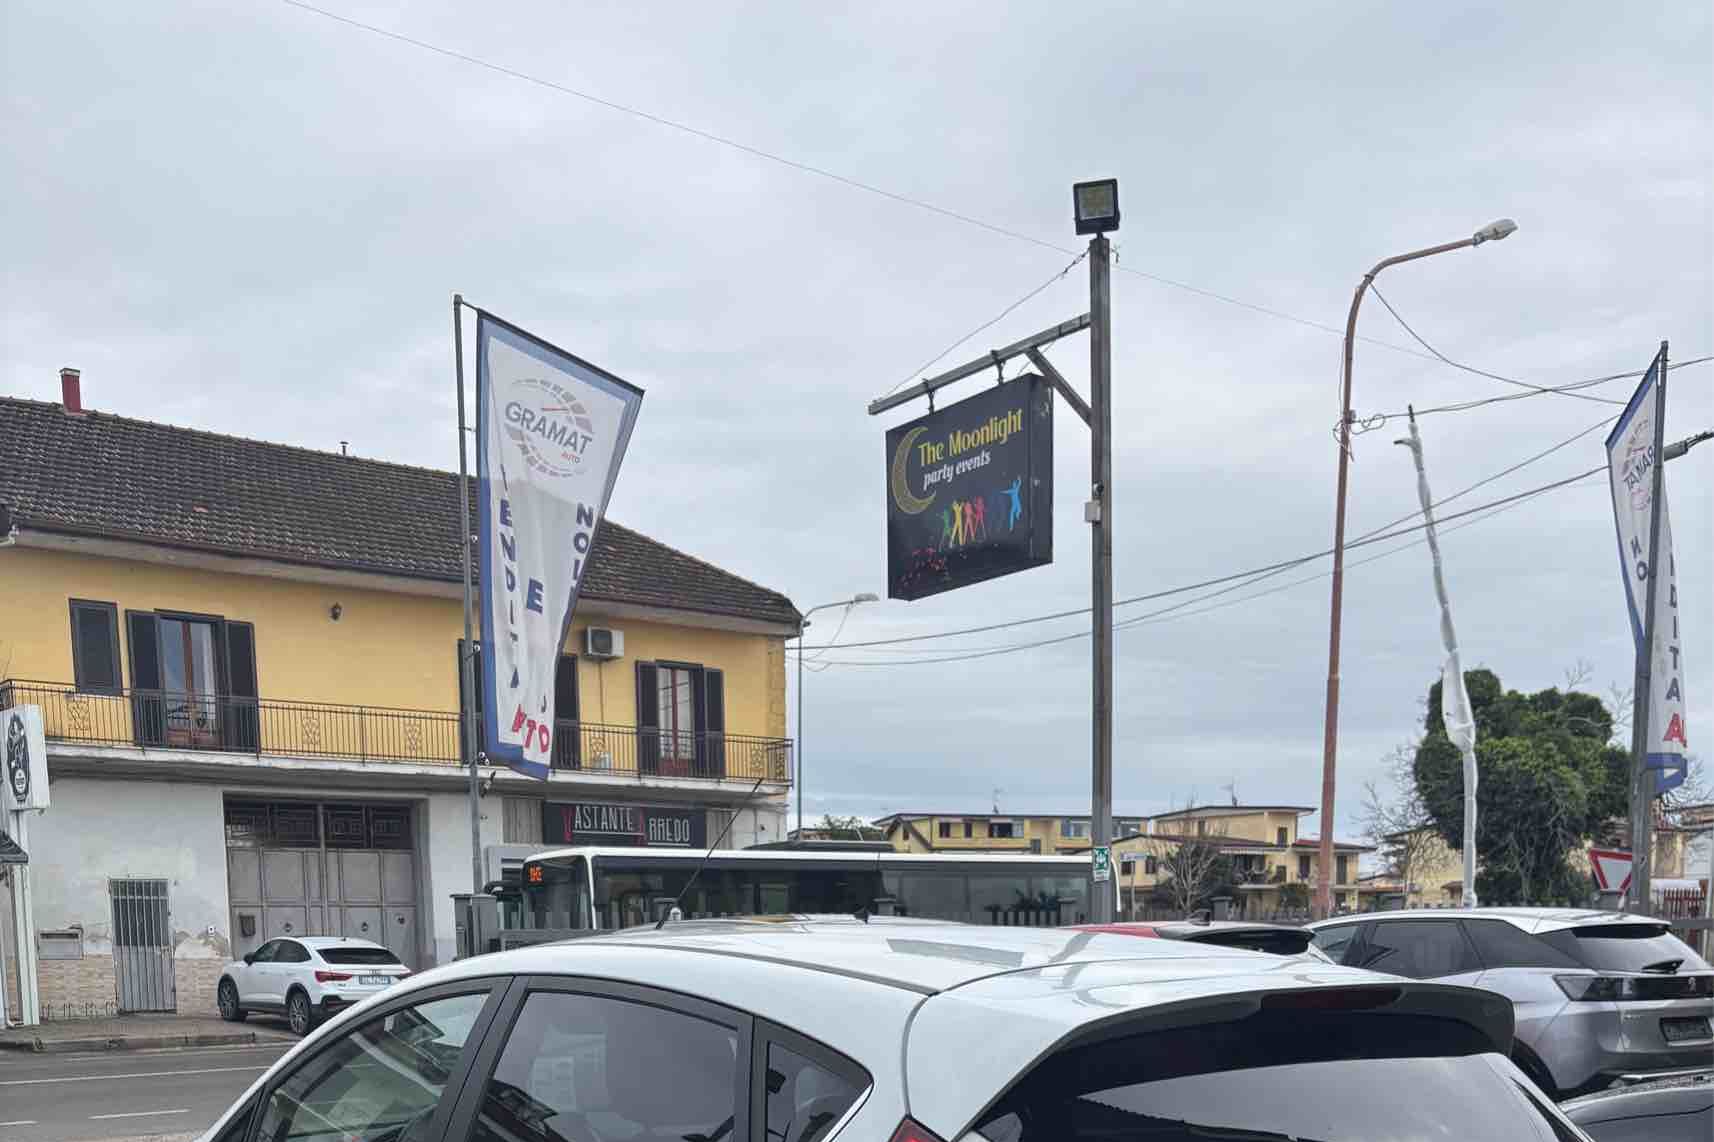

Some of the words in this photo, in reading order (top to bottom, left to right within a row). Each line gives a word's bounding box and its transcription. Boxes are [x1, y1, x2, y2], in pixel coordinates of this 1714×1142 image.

[505, 401, 593, 455] GRAMAT
[918, 440, 945, 466] The
[949, 407, 1023, 457] Moonlight
[923, 463, 954, 491] party
[955, 449, 992, 475] events
[526, 576, 544, 614] E
